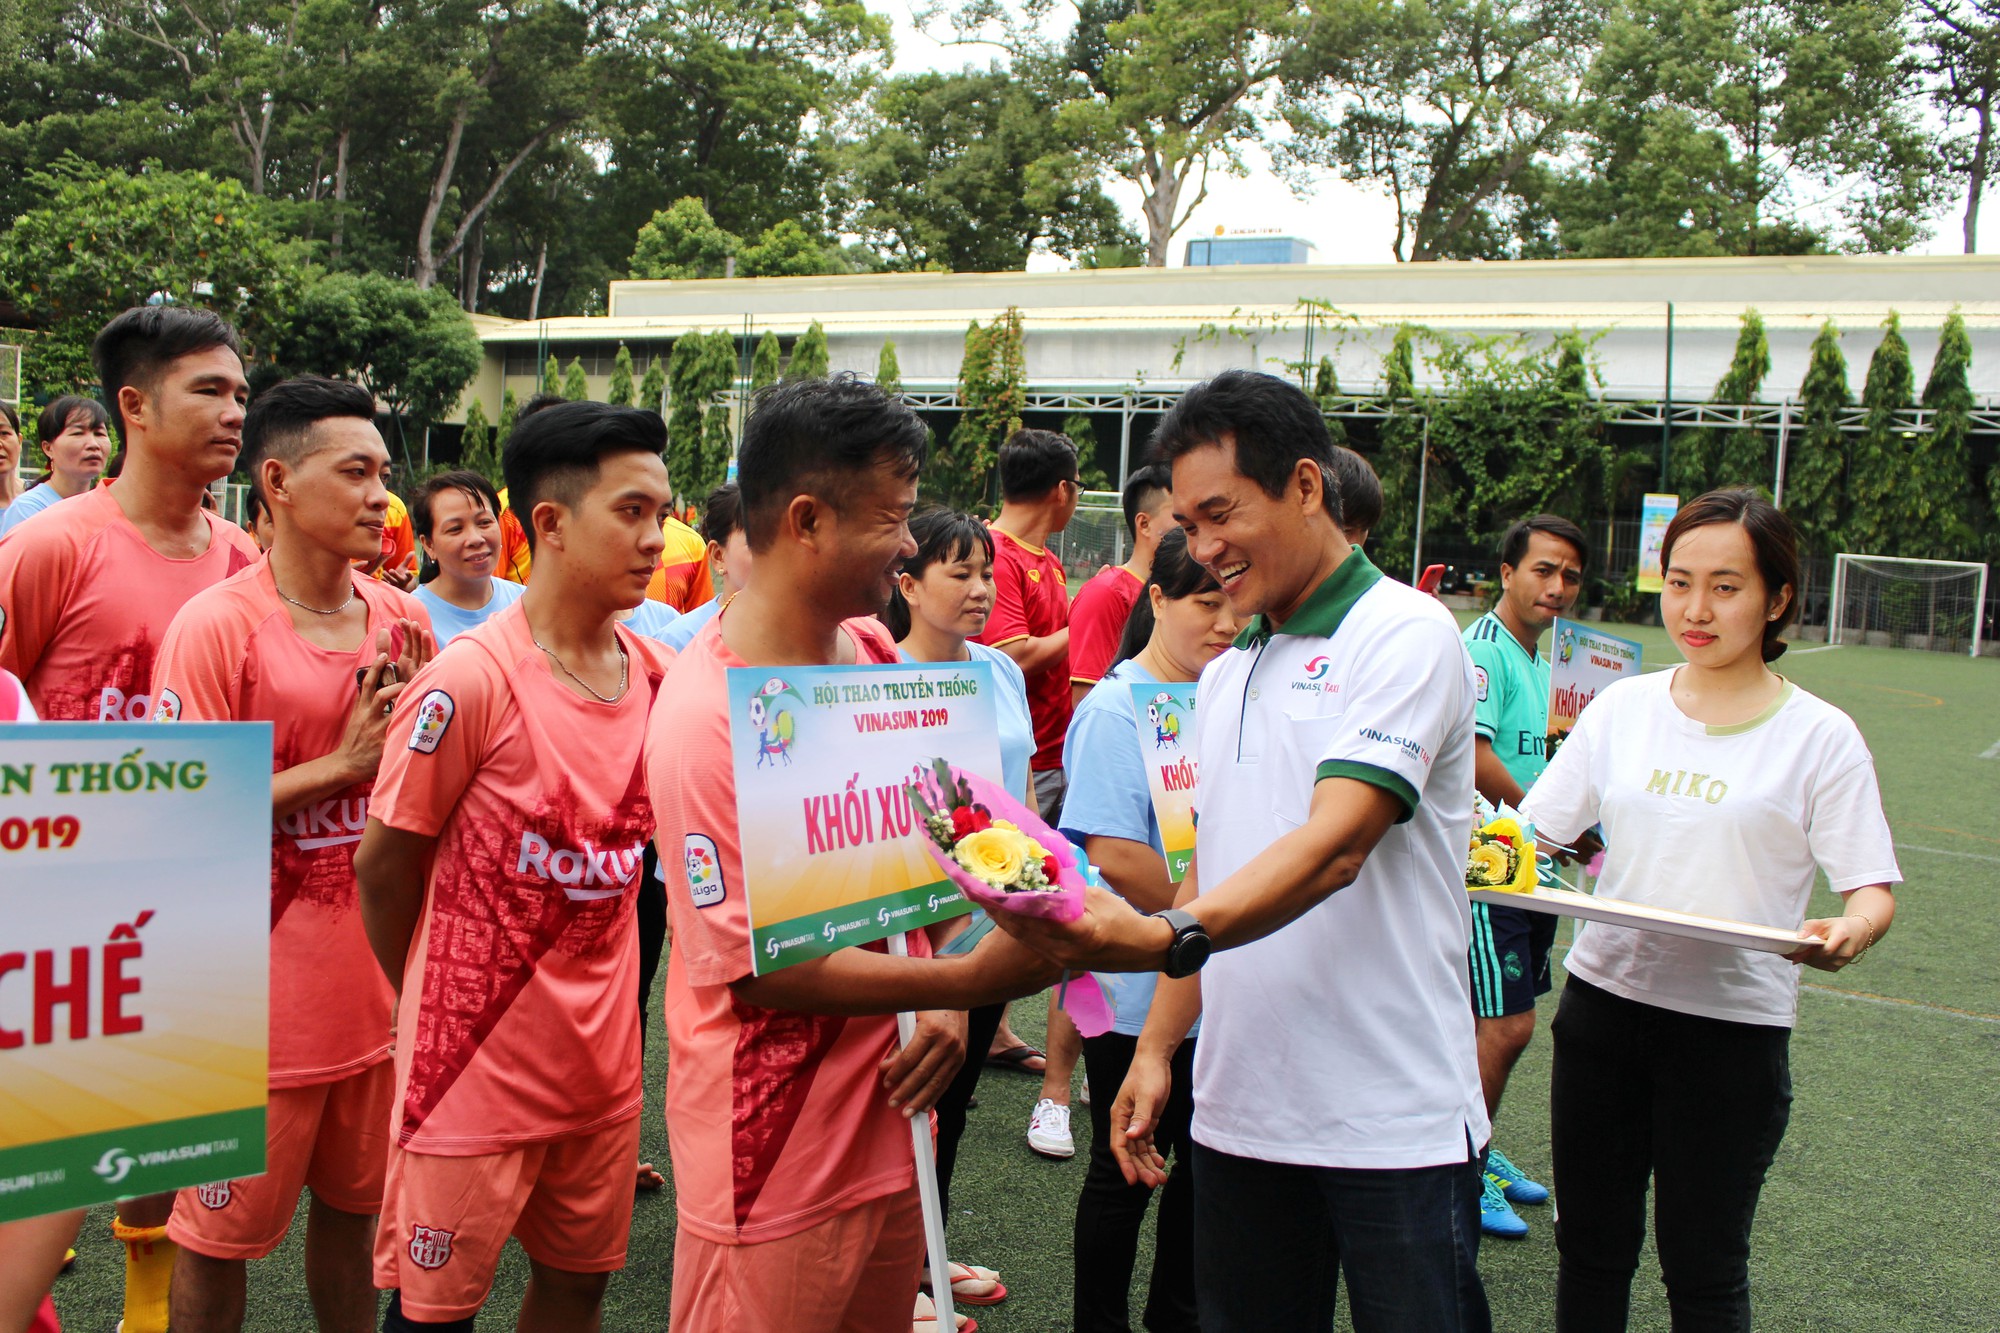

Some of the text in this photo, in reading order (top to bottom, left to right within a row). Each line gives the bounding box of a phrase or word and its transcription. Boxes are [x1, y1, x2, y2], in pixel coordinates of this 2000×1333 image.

[813, 673, 978, 709] HỘI THAO TRUYỀN THỐNG
[1554, 683, 1578, 719] KHỐI
[853, 708, 948, 733] VINASUN 2019
[50, 747, 208, 794] THỐNG
[1400, 747, 1418, 761] GREEN
[1160, 755, 1195, 792] KHỐI
[1645, 769, 1729, 804] MIKO
[803, 772, 873, 855] KHỐI
[0, 909, 156, 1050] CHẾ
